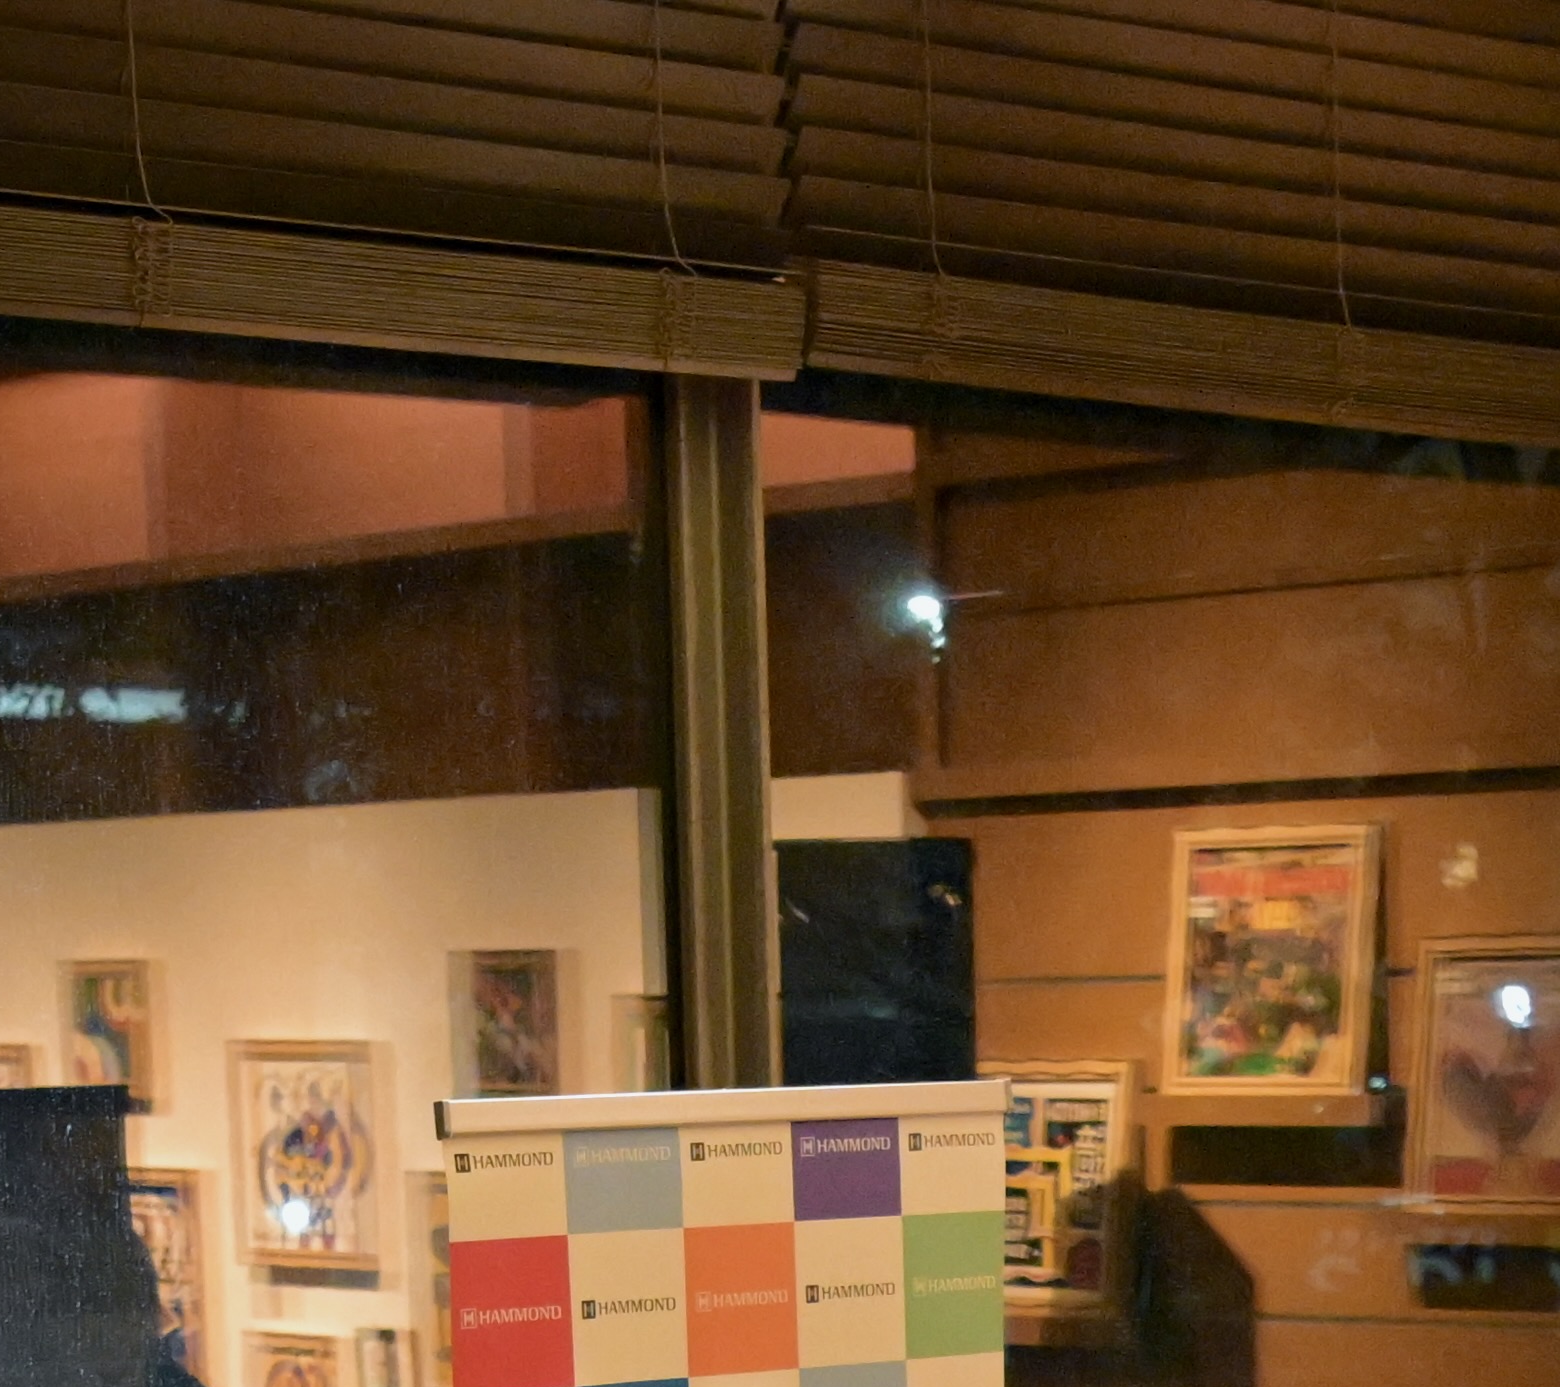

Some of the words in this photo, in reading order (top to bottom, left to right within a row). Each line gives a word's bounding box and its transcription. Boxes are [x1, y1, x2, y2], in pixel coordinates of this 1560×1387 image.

[706, 1140, 783, 1159] HAMMOND
[817, 1136, 892, 1154] HAMMOND
[923, 1132, 996, 1150] HAMMOND
[473, 1152, 554, 1171] HAMMOND
[590, 1145, 671, 1166] HAMMOND
[820, 1282, 895, 1302] HAMMOND
[928, 1276, 996, 1295] HAMMOND
[597, 1297, 676, 1317] HAMMOND
[713, 1289, 789, 1308] HAMMOND
[479, 1305, 562, 1325] HAMMOND
